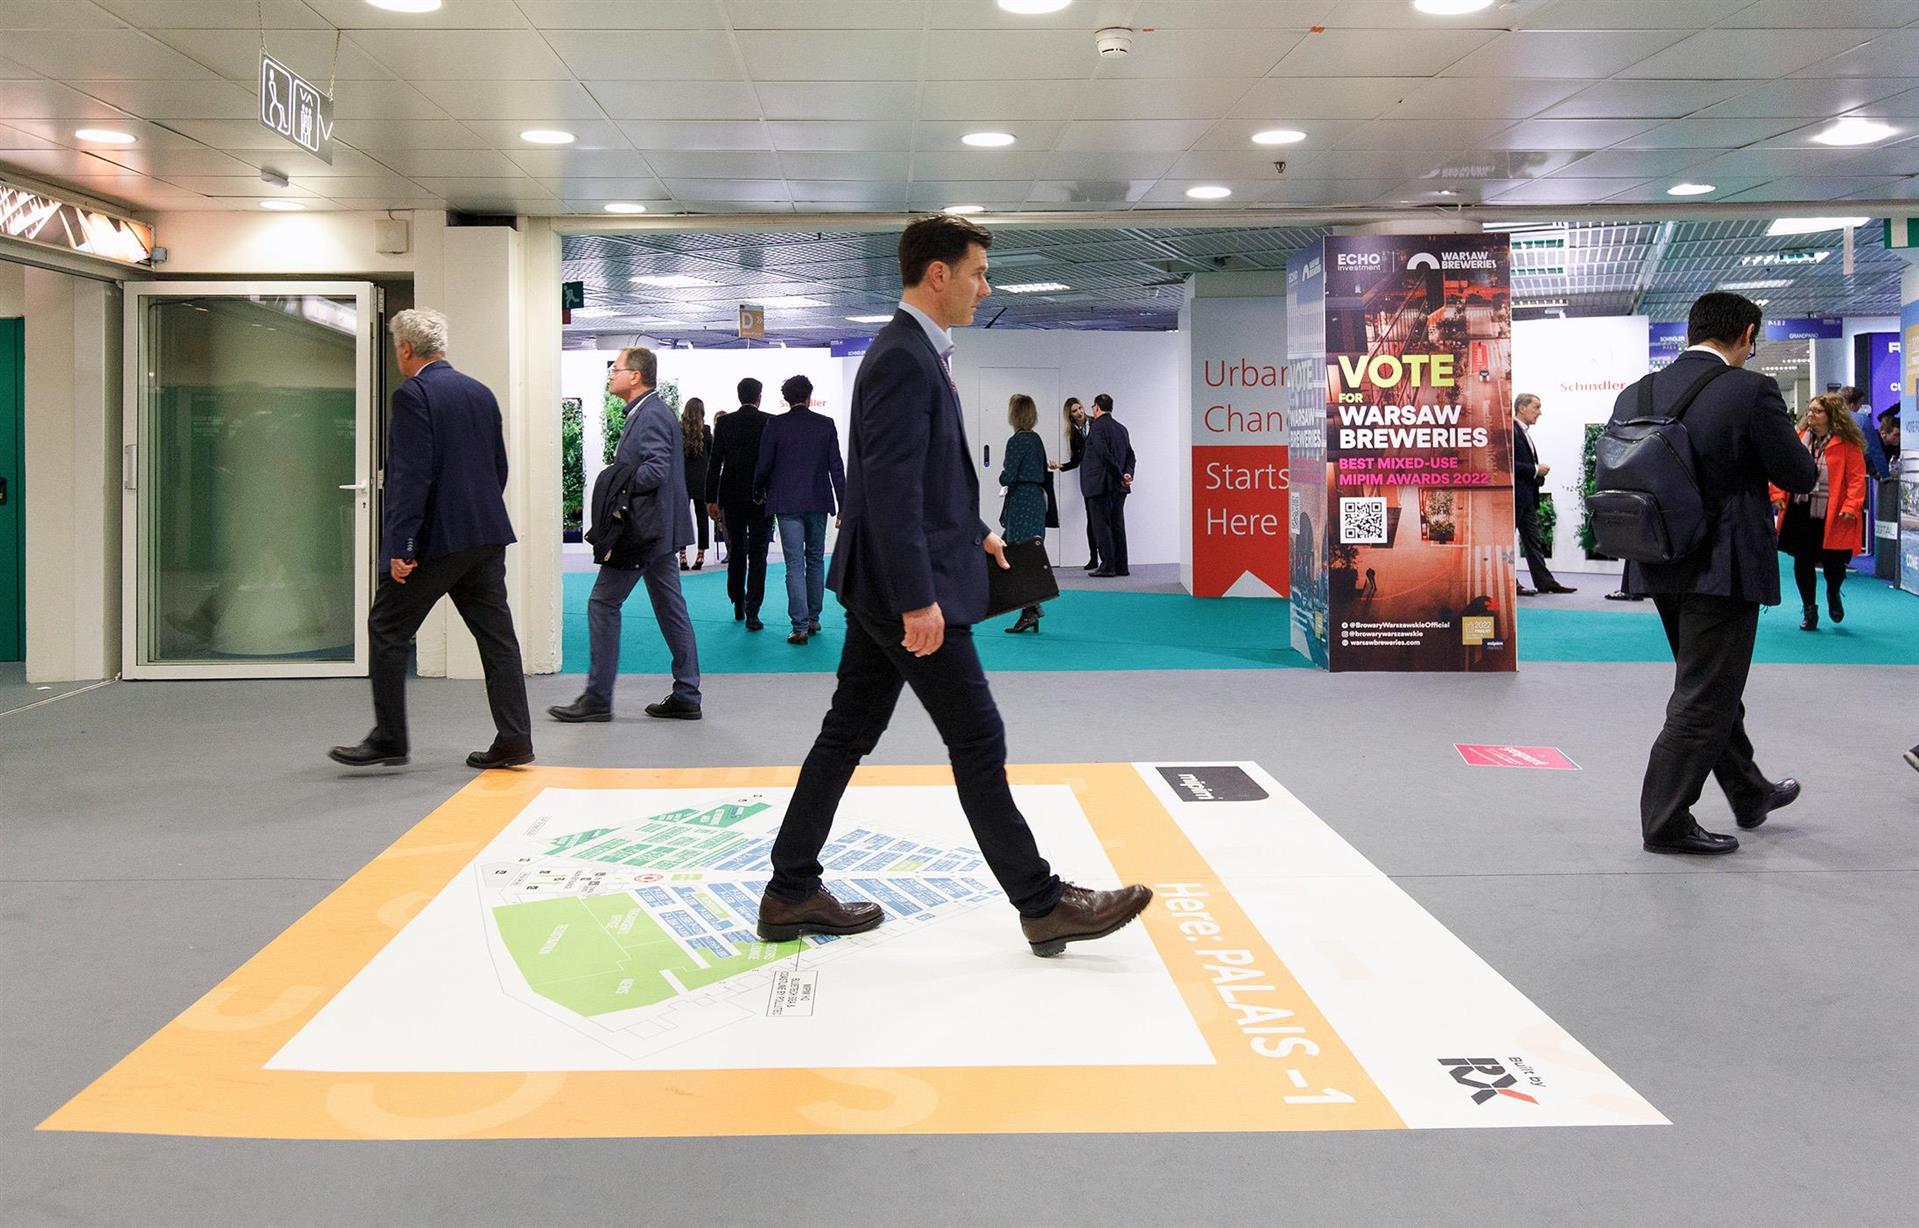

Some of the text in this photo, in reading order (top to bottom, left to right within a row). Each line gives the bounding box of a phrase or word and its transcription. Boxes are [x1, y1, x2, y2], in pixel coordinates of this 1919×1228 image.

[1338, 253, 1381, 265] ECHO
[1441, 252, 1489, 260] WARSAW
[1441, 260, 1497, 269] BREWERIES
[1338, 354, 1456, 388] VOTE
[1560, 380, 1626, 392] Schindler
[1338, 393, 1363, 403] FOR
[1339, 405, 1462, 426] WARSAW
[1339, 427, 1489, 449] BREWERIES
[1339, 457, 1459, 470] BEST MIXED-USE
[1206, 462, 1290, 490] Starts
[1339, 473, 1489, 486] MIPIM AWARDS 2022
[1207, 508, 1279, 536] Here
[1177, 773, 1216, 800] mipim
[1155, 882, 1225, 942] Here:
[1194, 949, 1321, 1059] PALAIS
[1508, 1056, 1548, 1088] Built by
